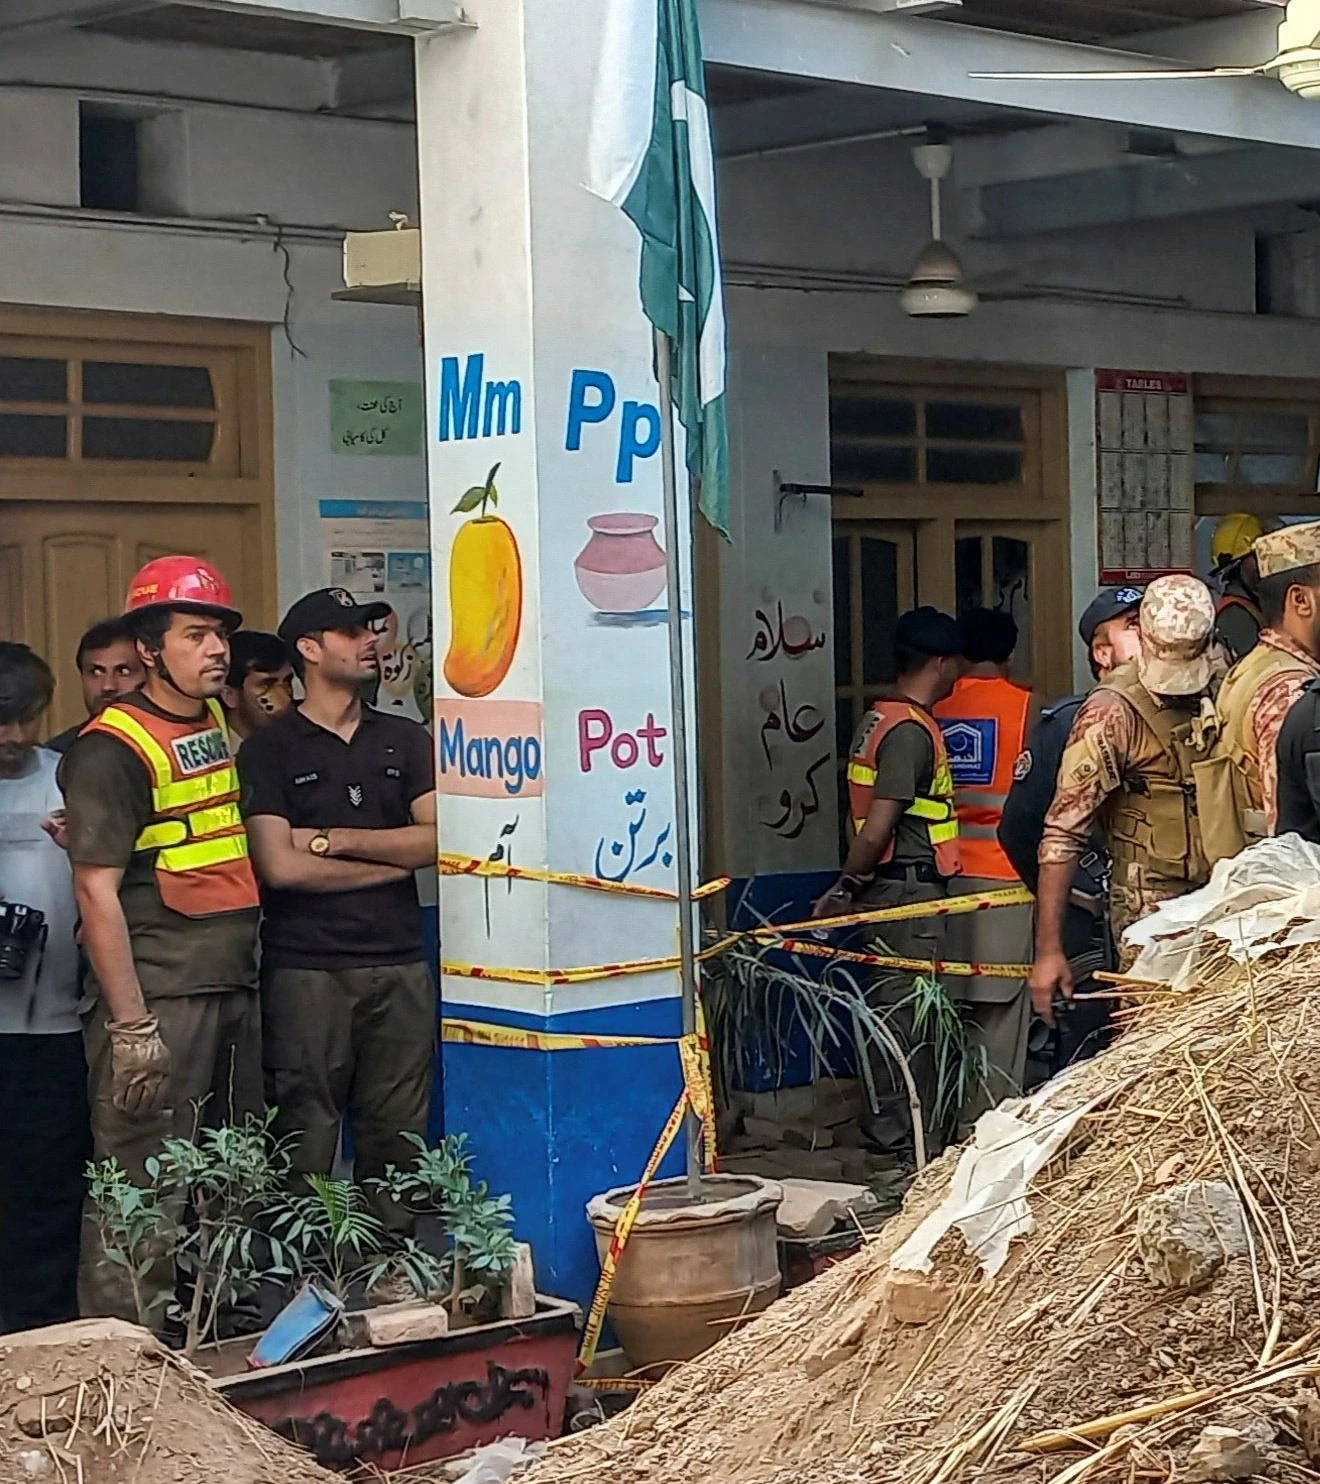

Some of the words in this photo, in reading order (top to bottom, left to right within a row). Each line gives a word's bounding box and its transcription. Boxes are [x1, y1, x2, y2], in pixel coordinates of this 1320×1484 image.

[439, 353, 521, 442] Mm
[565, 368, 662, 483] Pp
[1125, 378, 1162, 391] TABLES
[746, 600, 826, 662] سلام
[175, 731, 230, 770] RESC
[439, 716, 541, 795] Mango
[578, 709, 668, 772] Pot
[760, 679, 826, 773] عام
[594, 788, 673, 884] برتن
[758, 752, 832, 840] کرو
